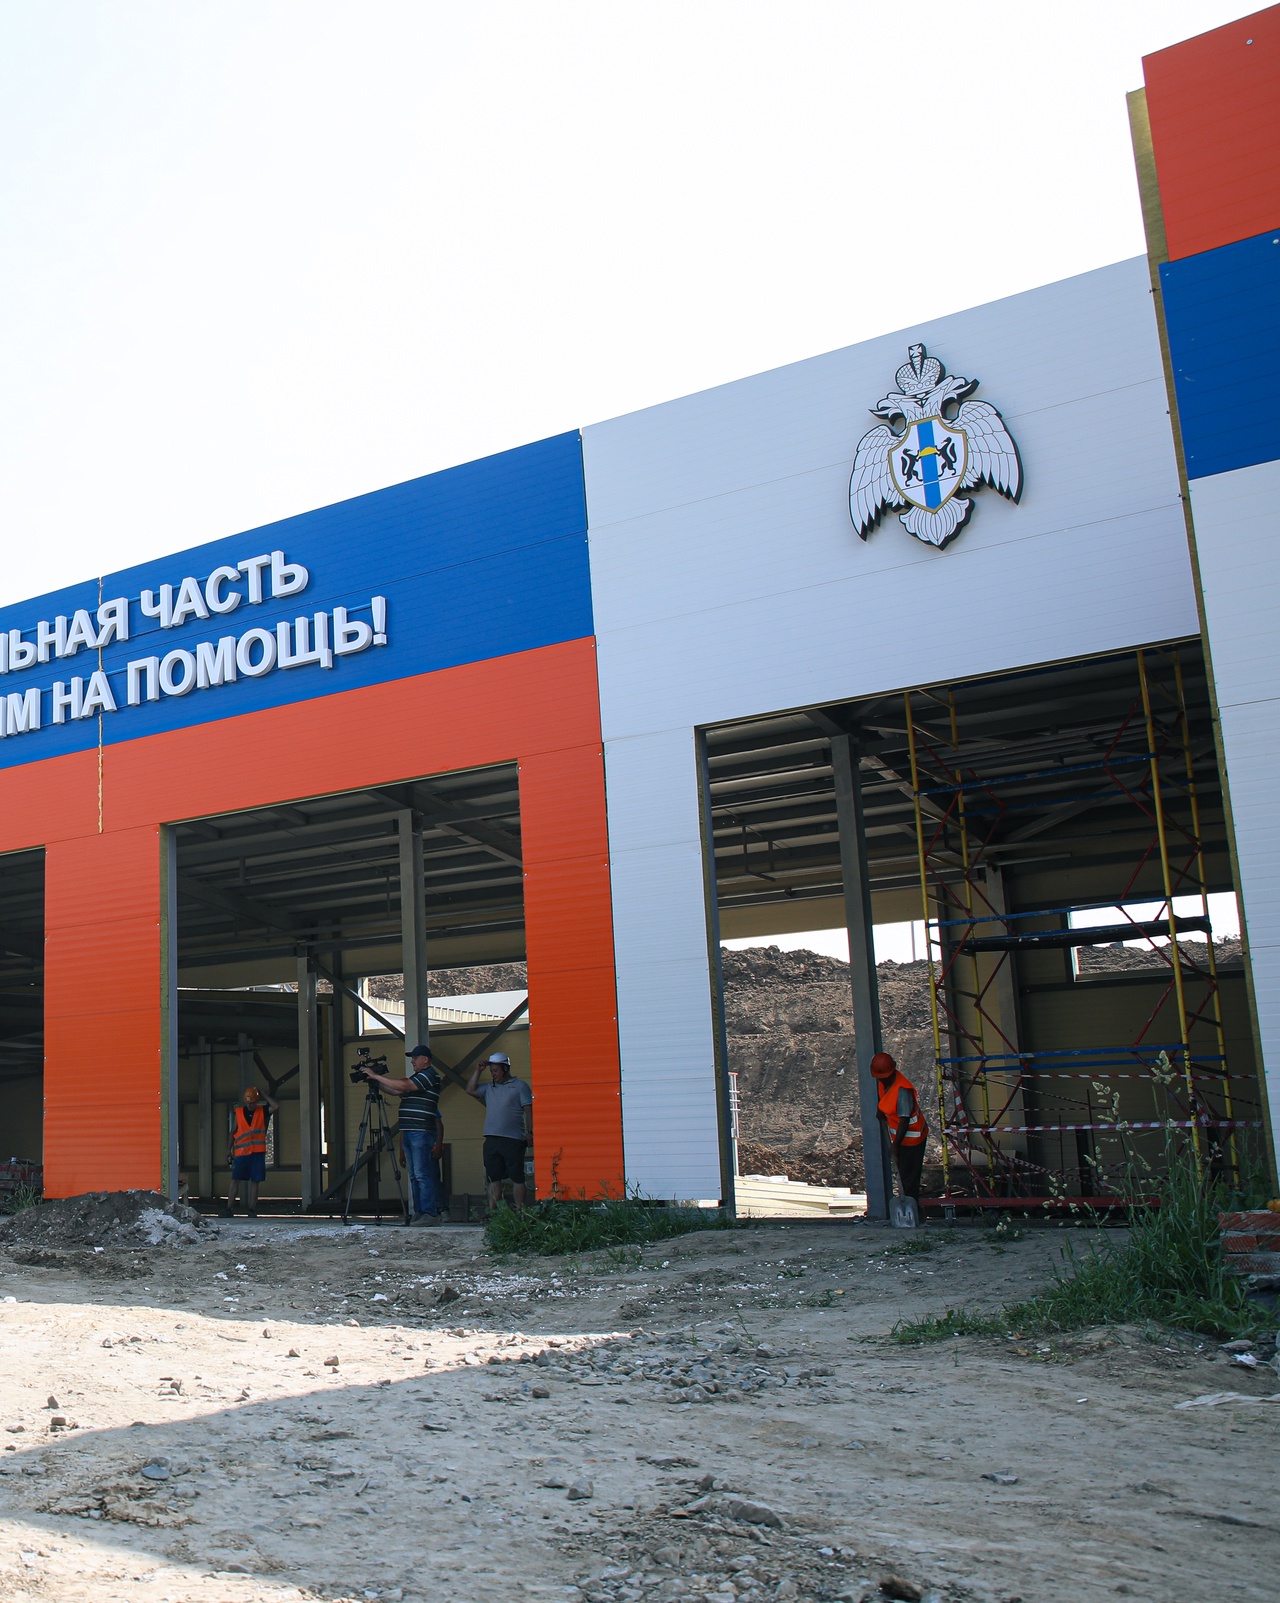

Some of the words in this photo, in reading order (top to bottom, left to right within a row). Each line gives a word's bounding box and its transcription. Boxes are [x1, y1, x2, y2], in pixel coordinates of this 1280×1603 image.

[141, 550, 309, 628] ЧАСТЬ
[52, 671, 117, 724] НА
[127, 596, 388, 706] ПОМОЩЬ!
